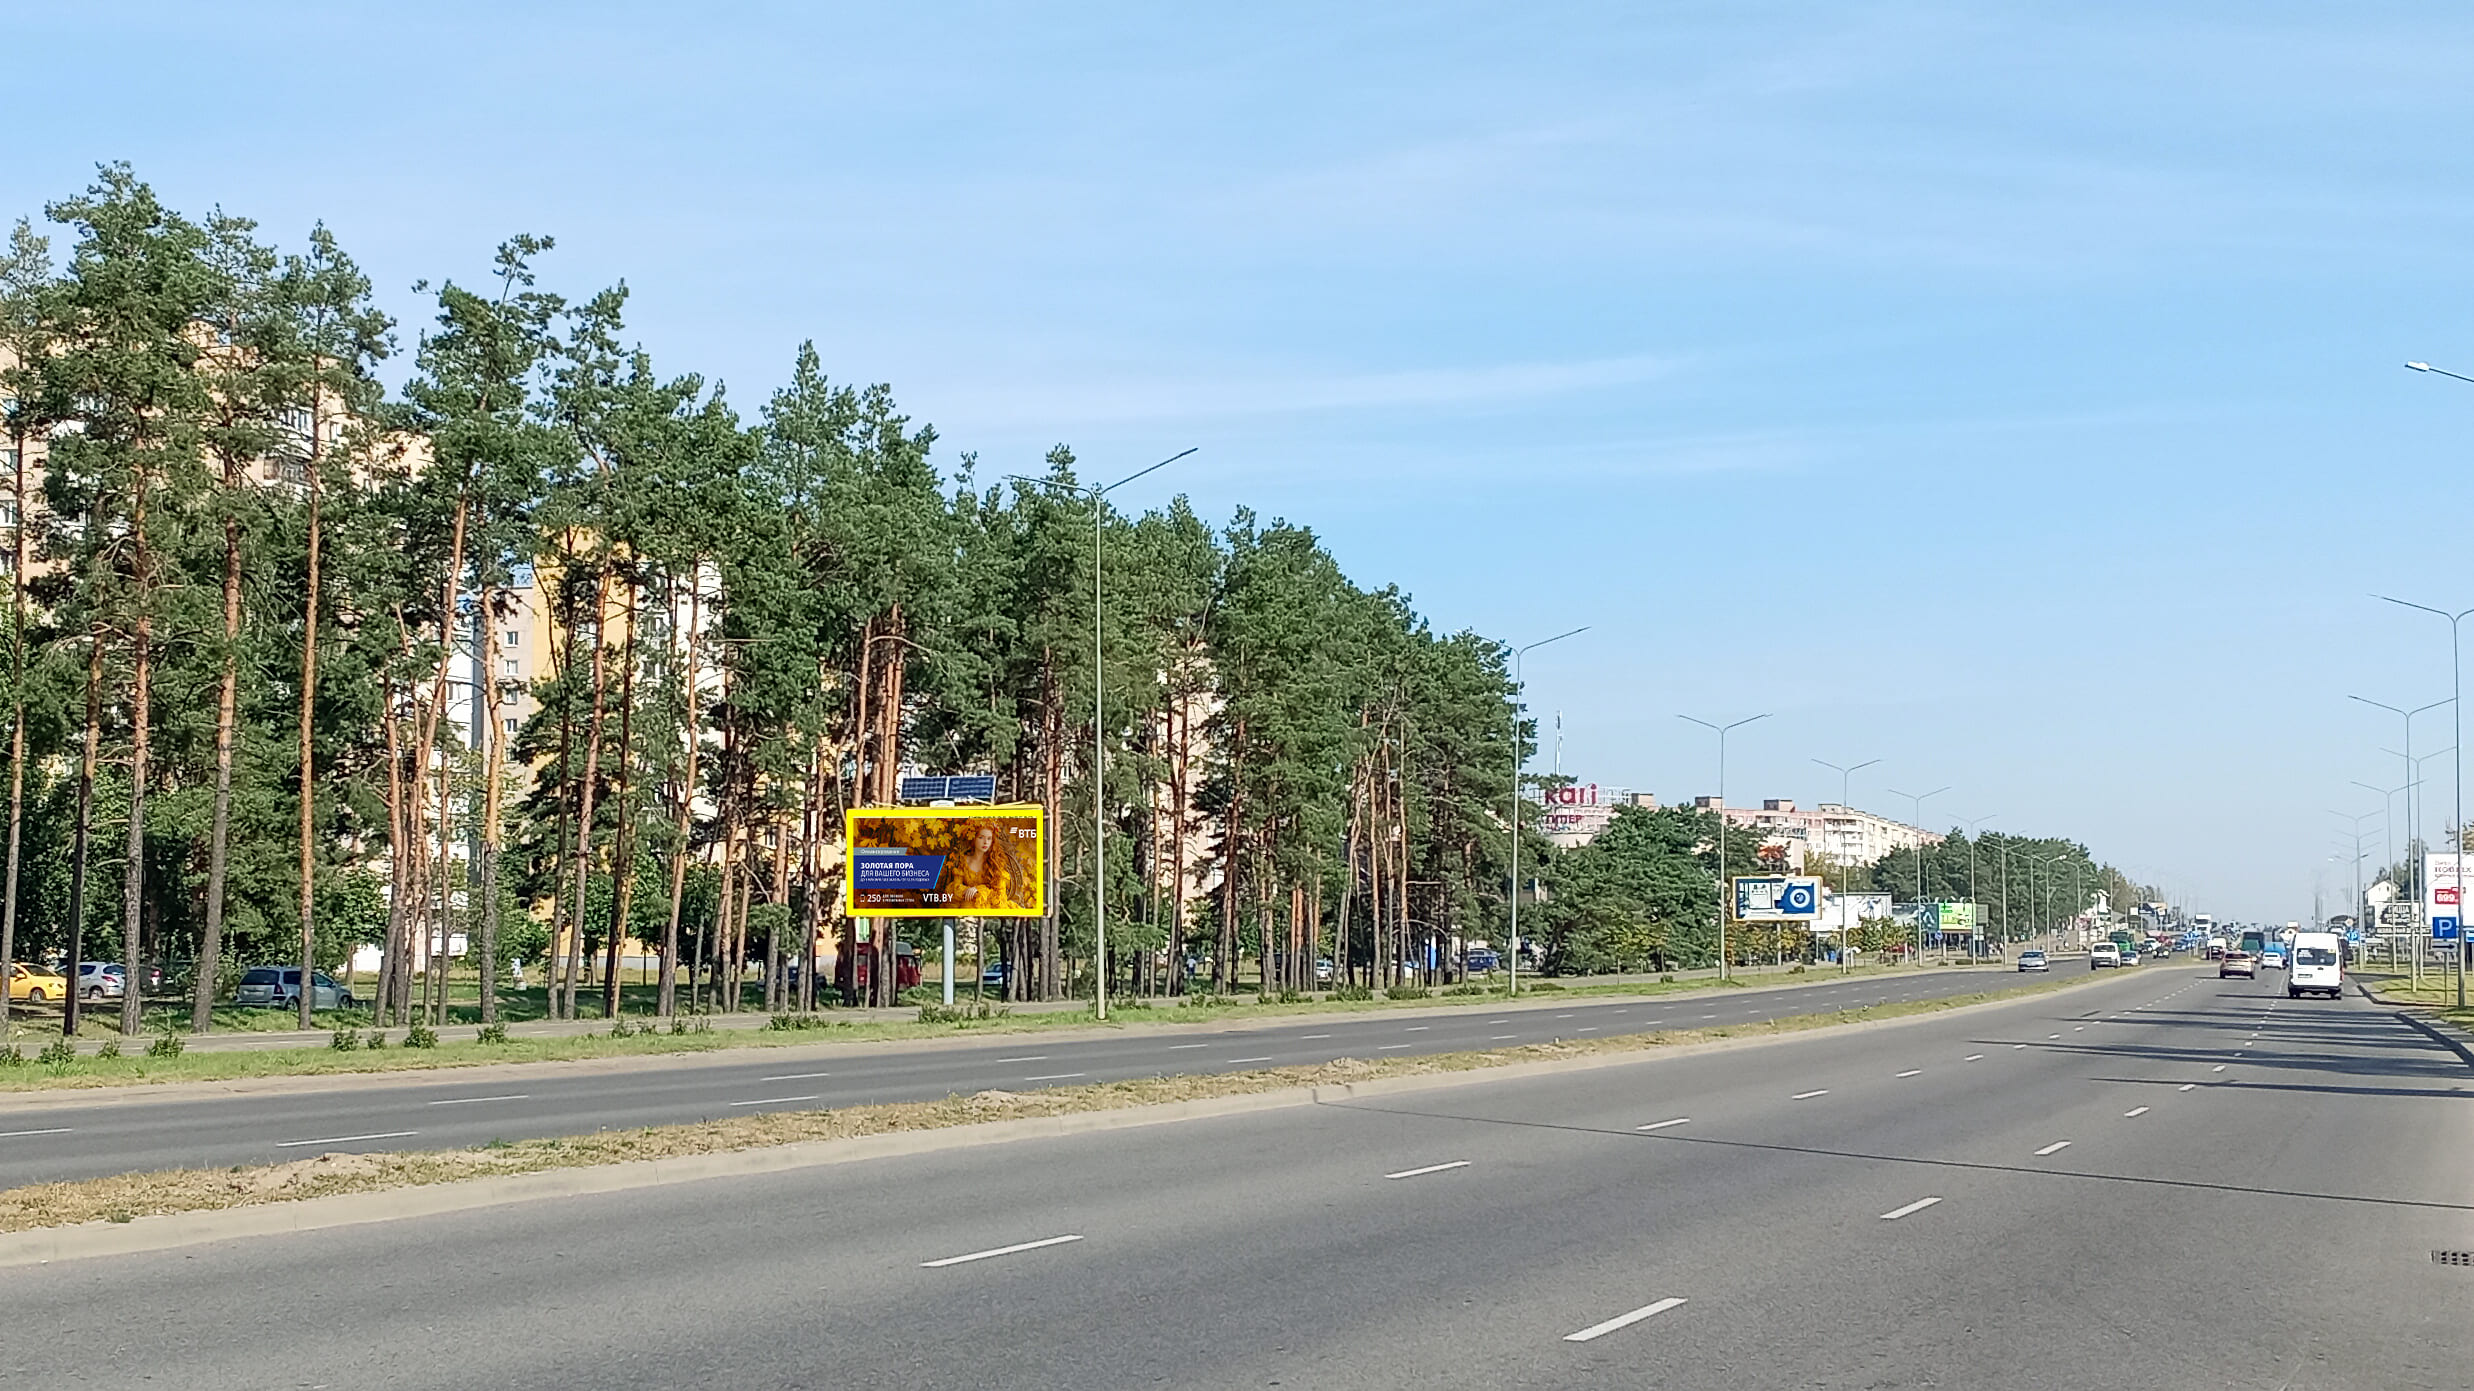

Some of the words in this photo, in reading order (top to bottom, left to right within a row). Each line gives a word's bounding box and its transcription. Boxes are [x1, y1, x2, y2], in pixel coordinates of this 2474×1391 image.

[1018, 829, 1037, 838] ВТБ
[860, 870, 874, 878] ДЛЯ
[867, 894, 881, 903] 250
[922, 893, 954, 902] VTB.BY
[2438, 919, 2453, 937] P
